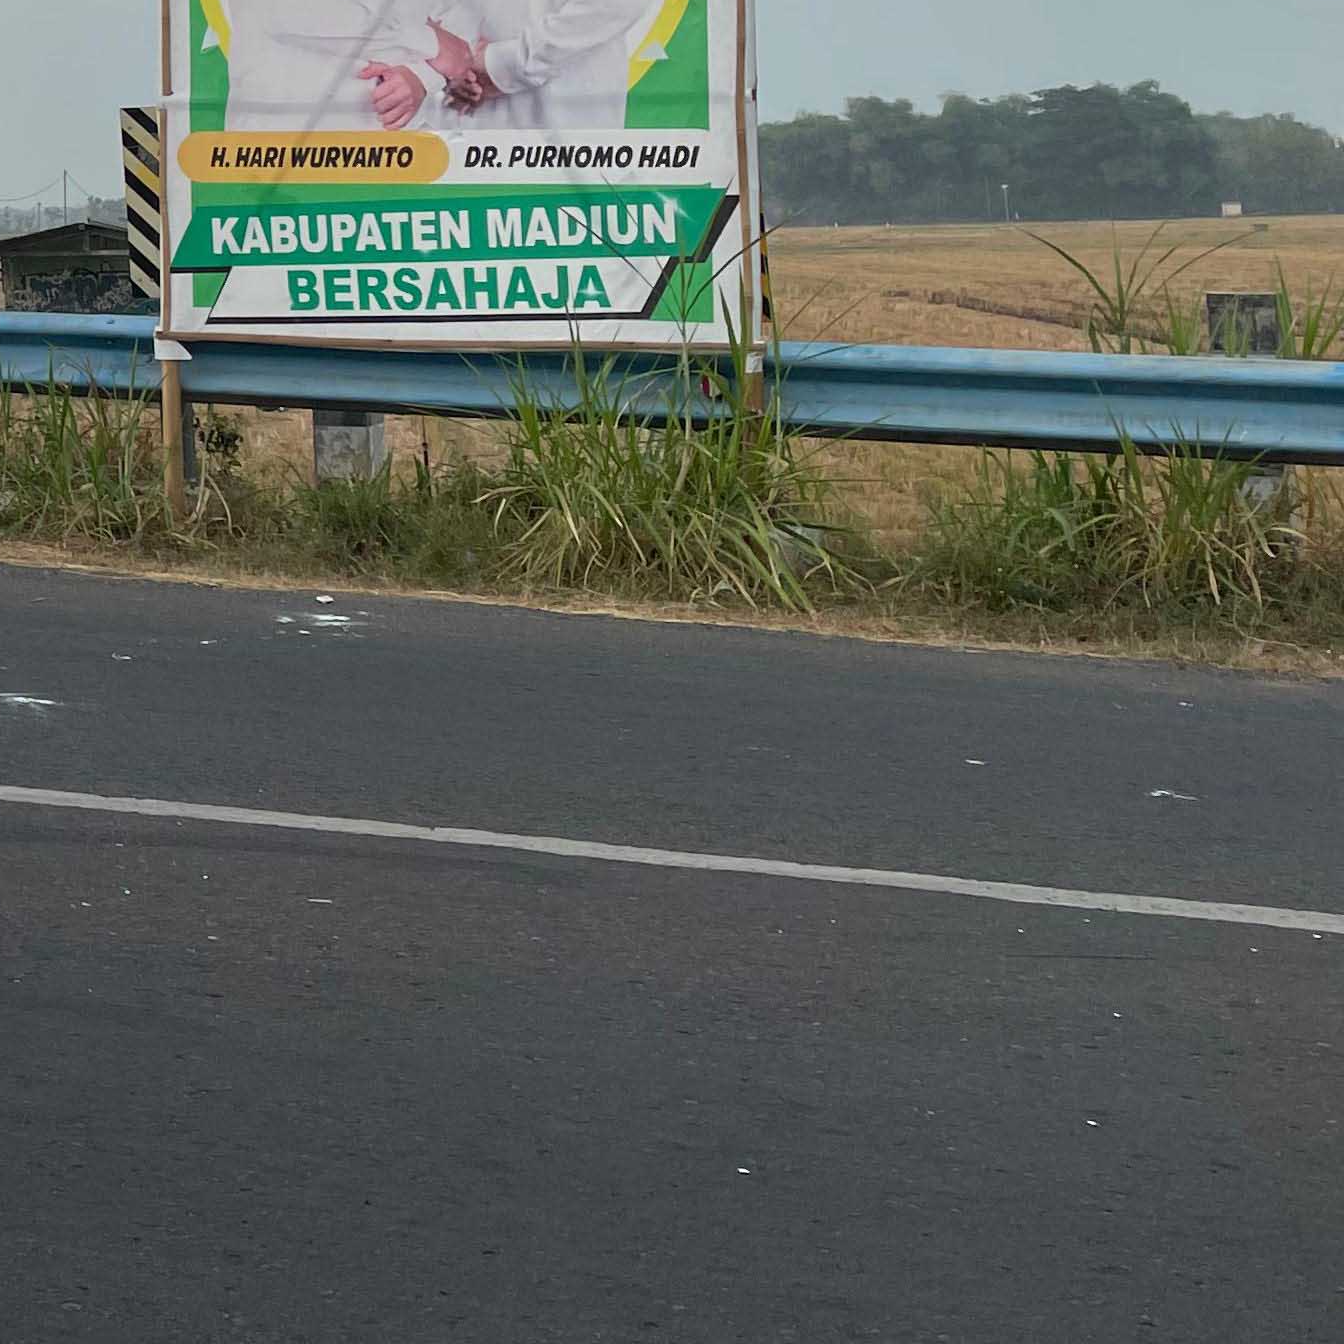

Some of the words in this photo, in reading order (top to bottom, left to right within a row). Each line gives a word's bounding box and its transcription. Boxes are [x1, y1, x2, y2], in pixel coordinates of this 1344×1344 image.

[210, 145, 231, 168] H.
[234, 146, 287, 168] HARI
[289, 145, 414, 168] WURYANTO
[464, 145, 504, 168] DR.
[509, 145, 634, 169] PURNOMO
[637, 145, 700, 168] HADI
[211, 209, 473, 257] KABUPATEN
[486, 201, 677, 251] MADIUN
[287, 264, 613, 312] BERSAHAJA
